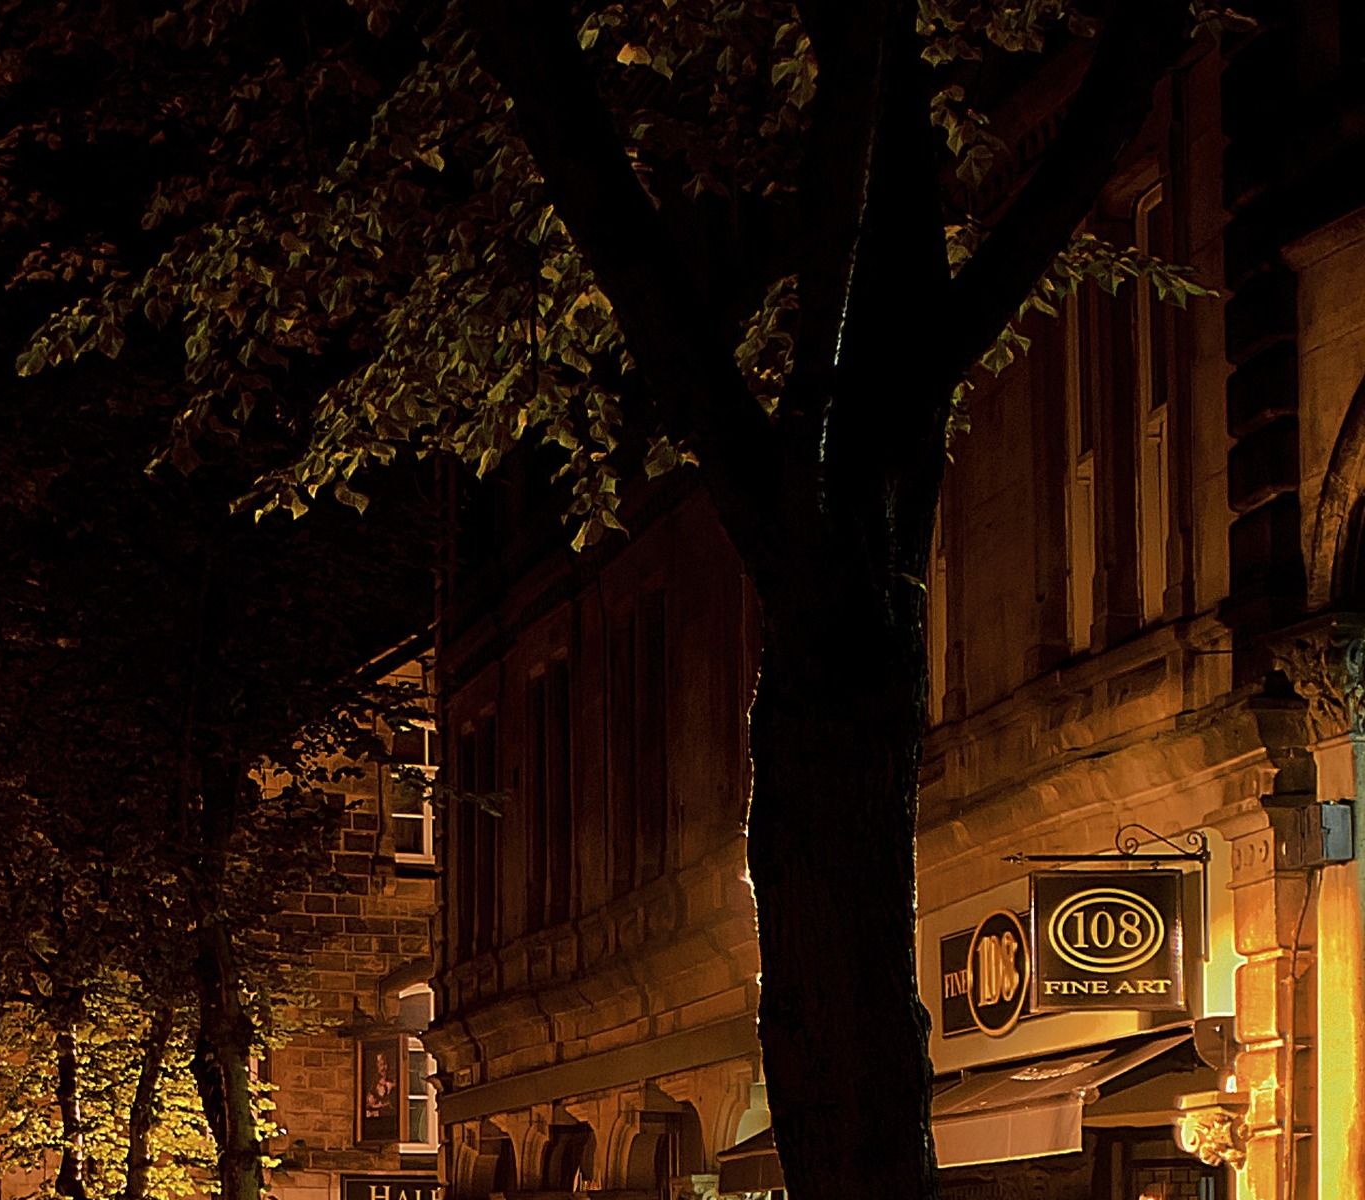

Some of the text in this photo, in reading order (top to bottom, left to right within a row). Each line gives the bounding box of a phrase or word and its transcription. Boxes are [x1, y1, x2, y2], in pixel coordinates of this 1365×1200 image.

[1072, 910, 1143, 949] 108
[1044, 980, 1172, 995] FINE ART
